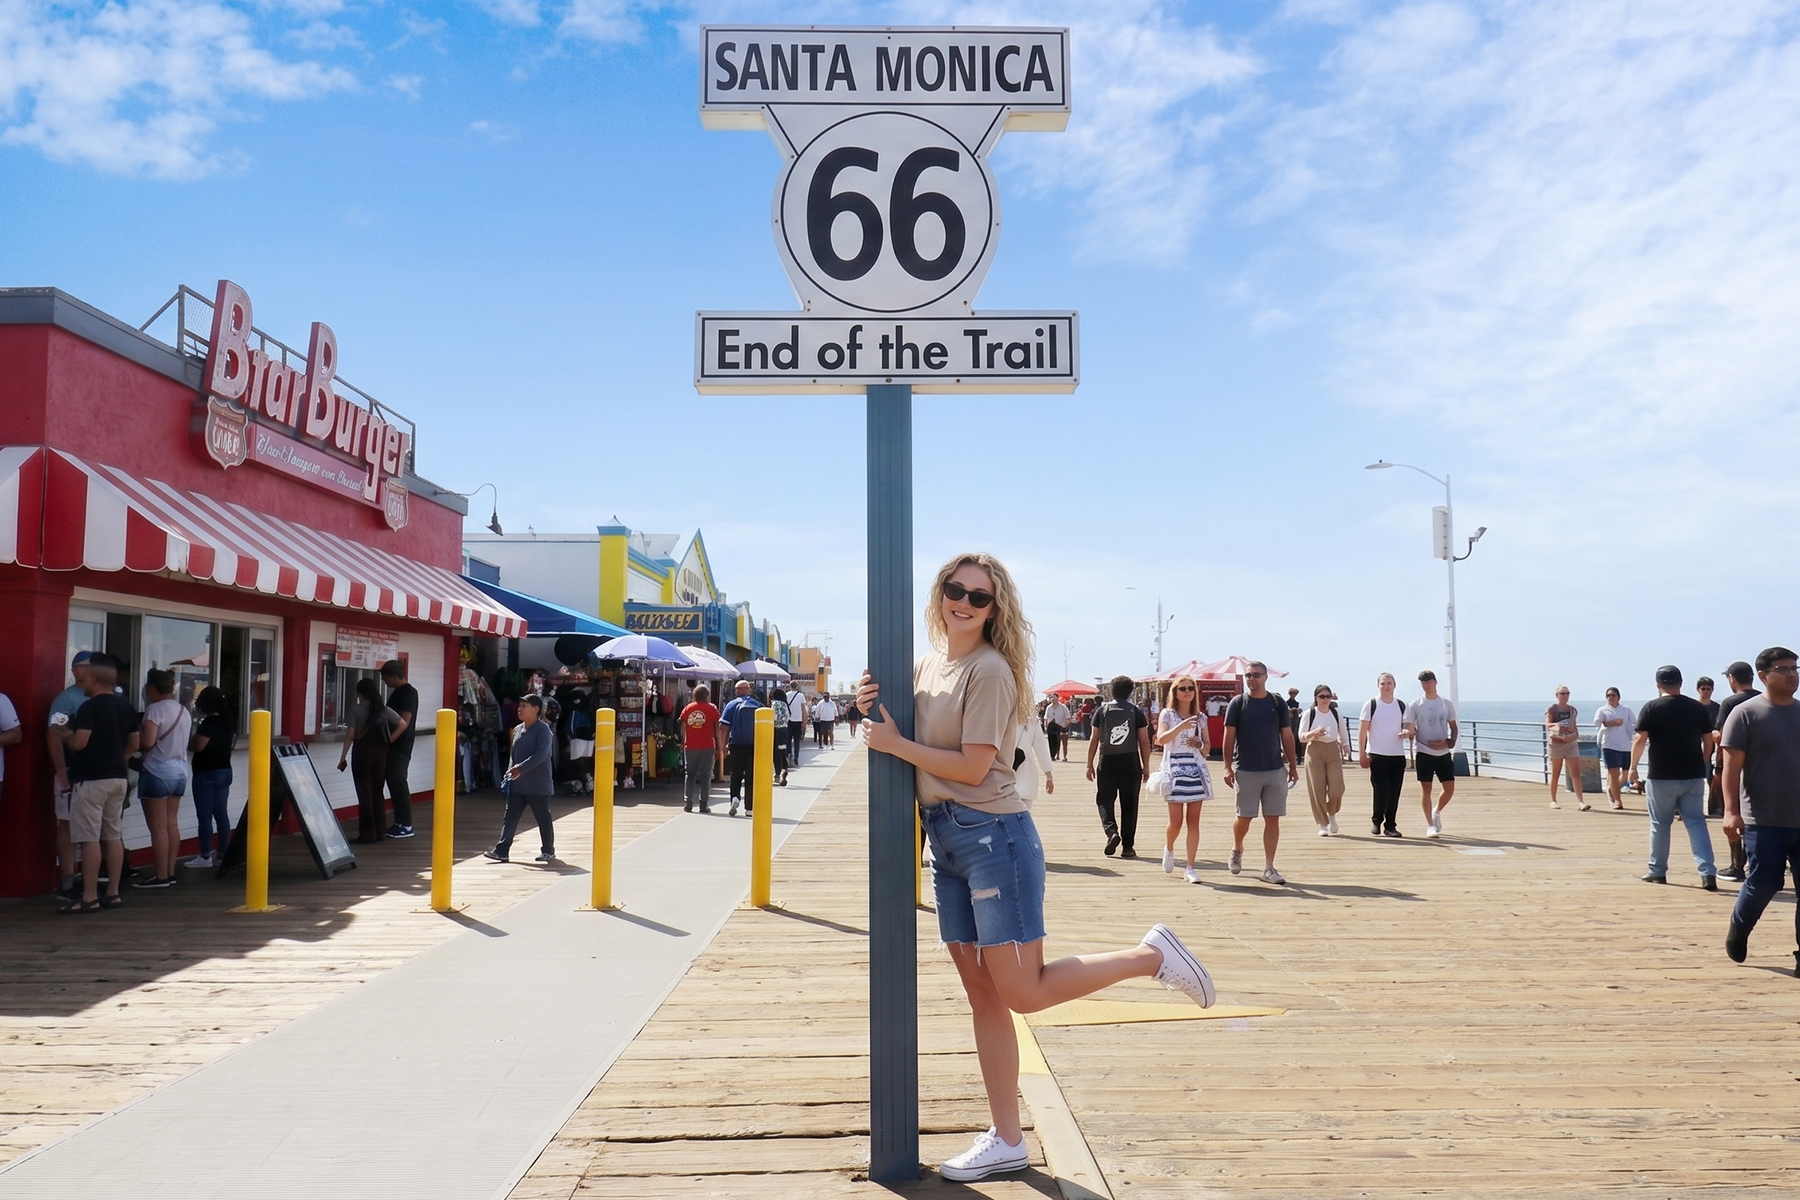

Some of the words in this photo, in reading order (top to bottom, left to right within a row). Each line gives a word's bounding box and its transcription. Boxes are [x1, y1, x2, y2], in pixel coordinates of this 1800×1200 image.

[716, 42, 857, 91] SANTA
[876, 45, 1055, 92] MONICA
[807, 147, 966, 281] 66
[718, 325, 799, 370] End
[817, 324, 863, 370] of
[879, 325, 949, 370] the
[963, 324, 1058, 370] Trail
